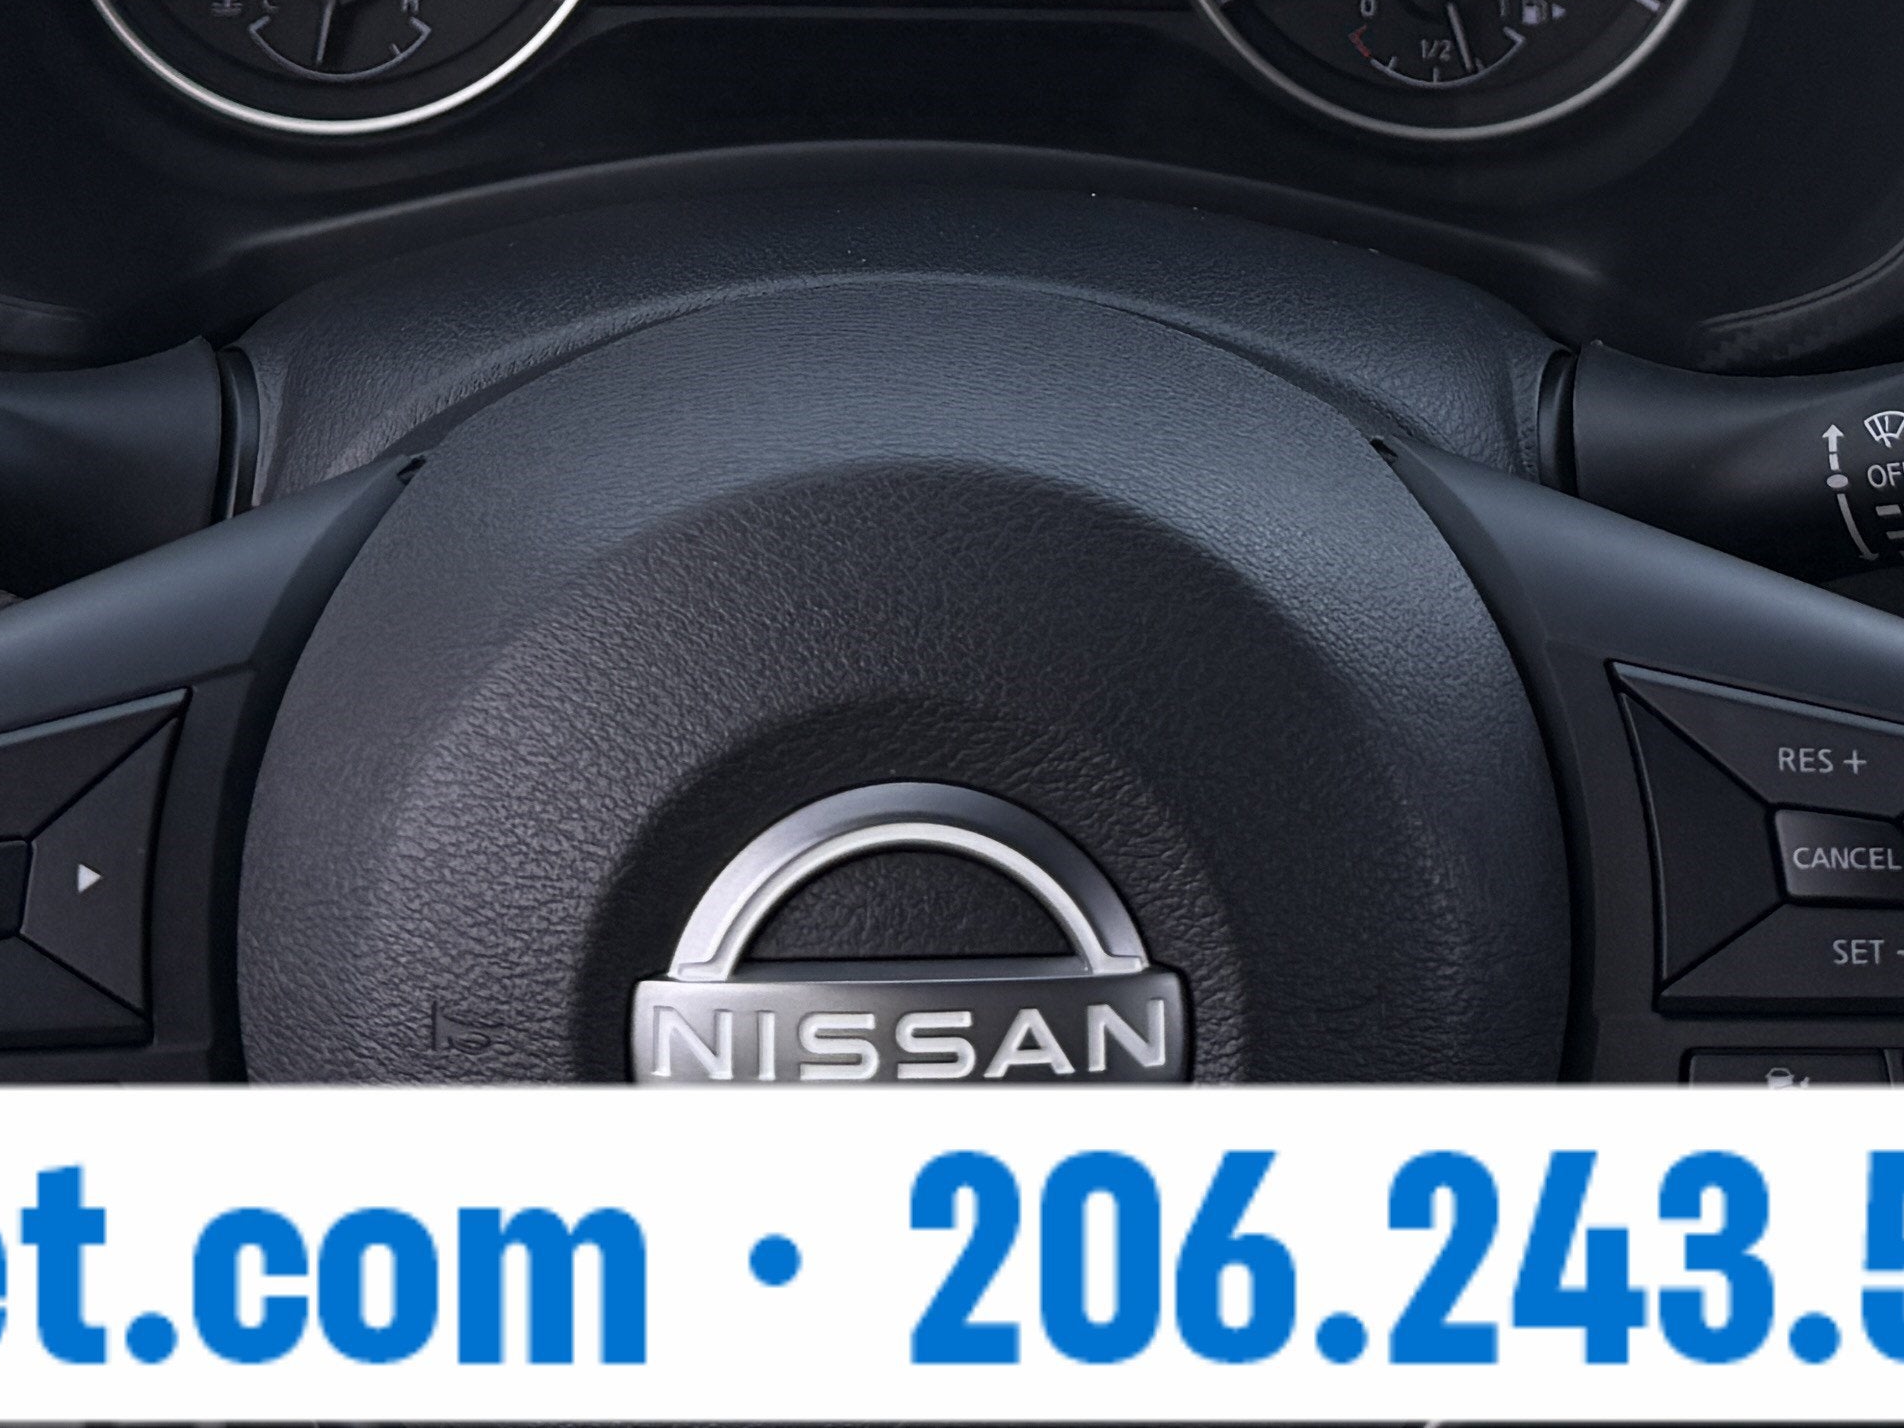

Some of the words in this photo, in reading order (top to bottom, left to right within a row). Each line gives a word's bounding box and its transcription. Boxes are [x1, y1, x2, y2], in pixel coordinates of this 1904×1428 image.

[1420, 38, 1452, 61] 1/2
[1778, 749, 1833, 774] RES
[1792, 846, 1902, 871] CANCEL
[1832, 939, 1884, 964] SET
[651, 997, 1168, 1082] NISSAN
